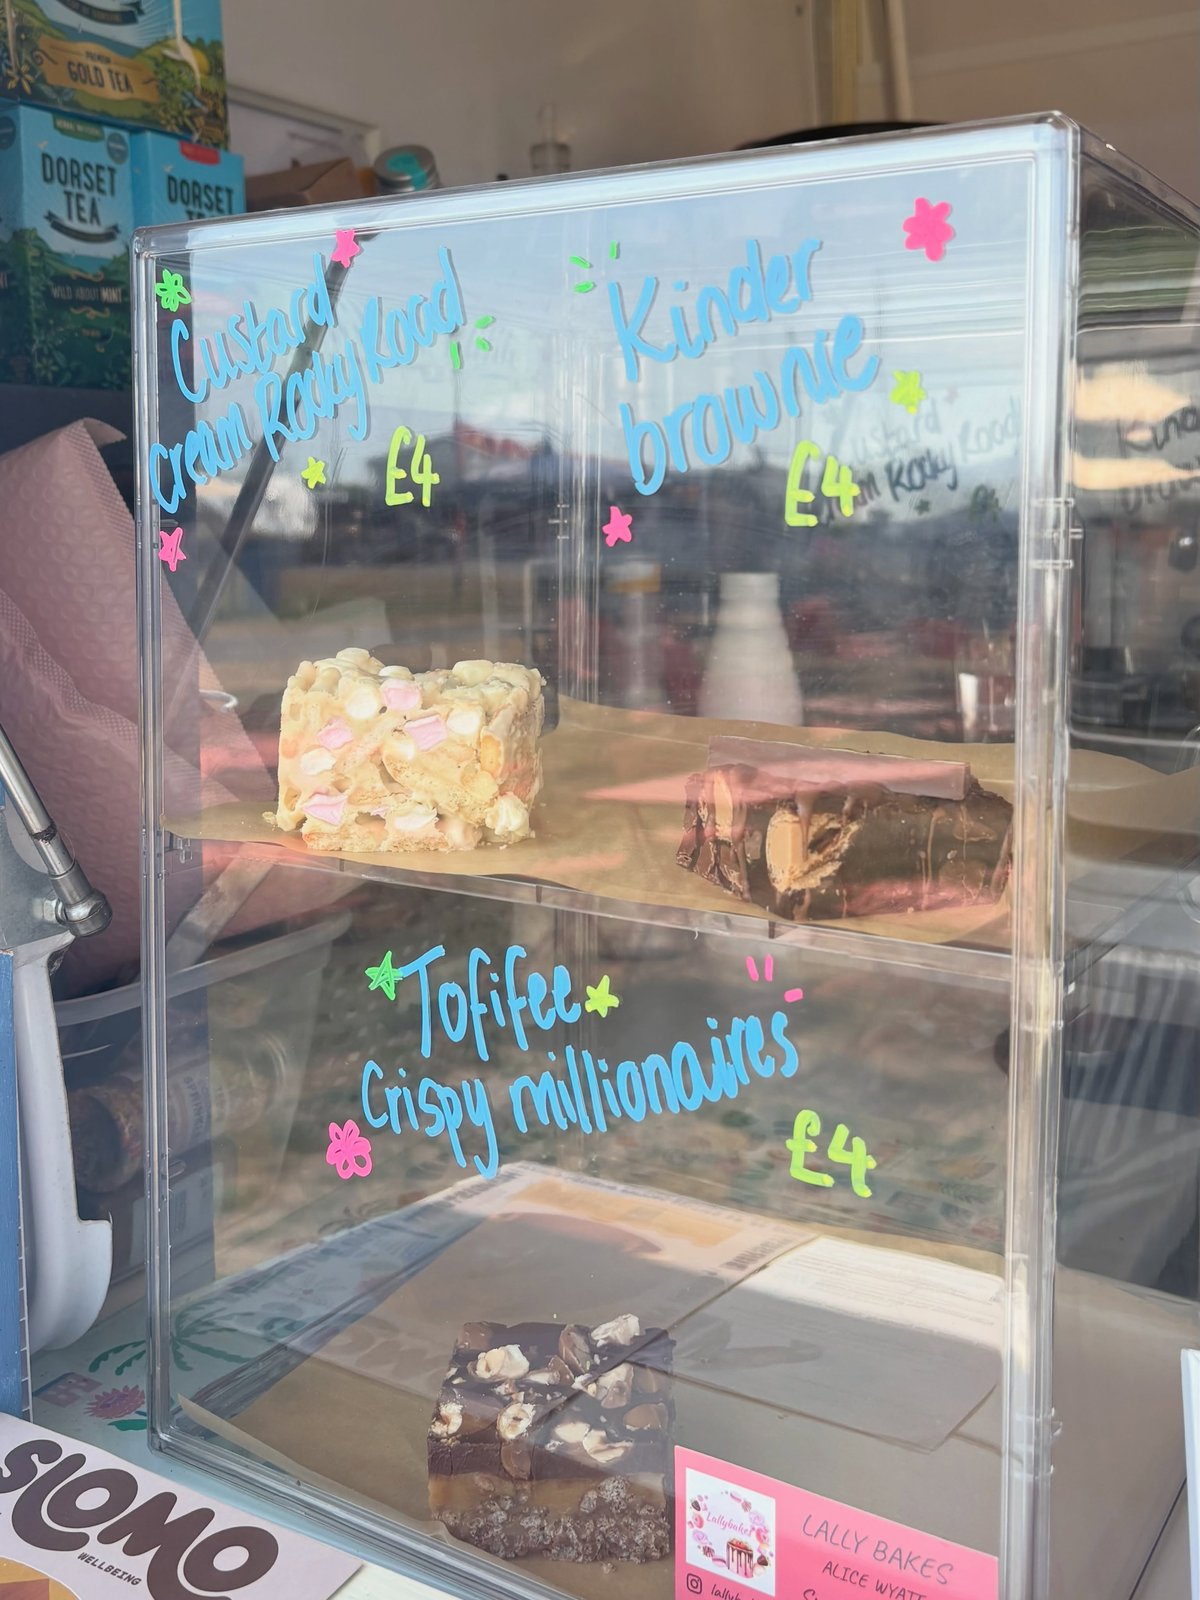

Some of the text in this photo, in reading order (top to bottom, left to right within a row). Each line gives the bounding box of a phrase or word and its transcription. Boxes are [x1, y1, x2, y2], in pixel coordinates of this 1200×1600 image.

[66, 61, 134, 94] GOLD TEA
[41, 152, 117, 197] DORSET
[63, 190, 102, 226] TEA
[167, 174, 234, 215] DORSET
[101, 286, 122, 304] MINT
[171, 252, 336, 404] Custard
[607, 238, 822, 384] Kinder
[254, 340, 369, 463] Rocky
[358, 246, 465, 385] Road
[619, 313, 881, 497] brownie
[385, 425, 441, 507] £4
[784, 440, 861, 527] £4
[397, 944, 583, 1062] Tofifee
[361, 1010, 799, 1180] Crispy millionaires
[784, 1109, 878, 1199] £4
[77, 1551, 142, 1587] WELLBEING
[802, 1513, 955, 1586] LALLY BAKES
[822, 1560, 870, 1588] ALICE
